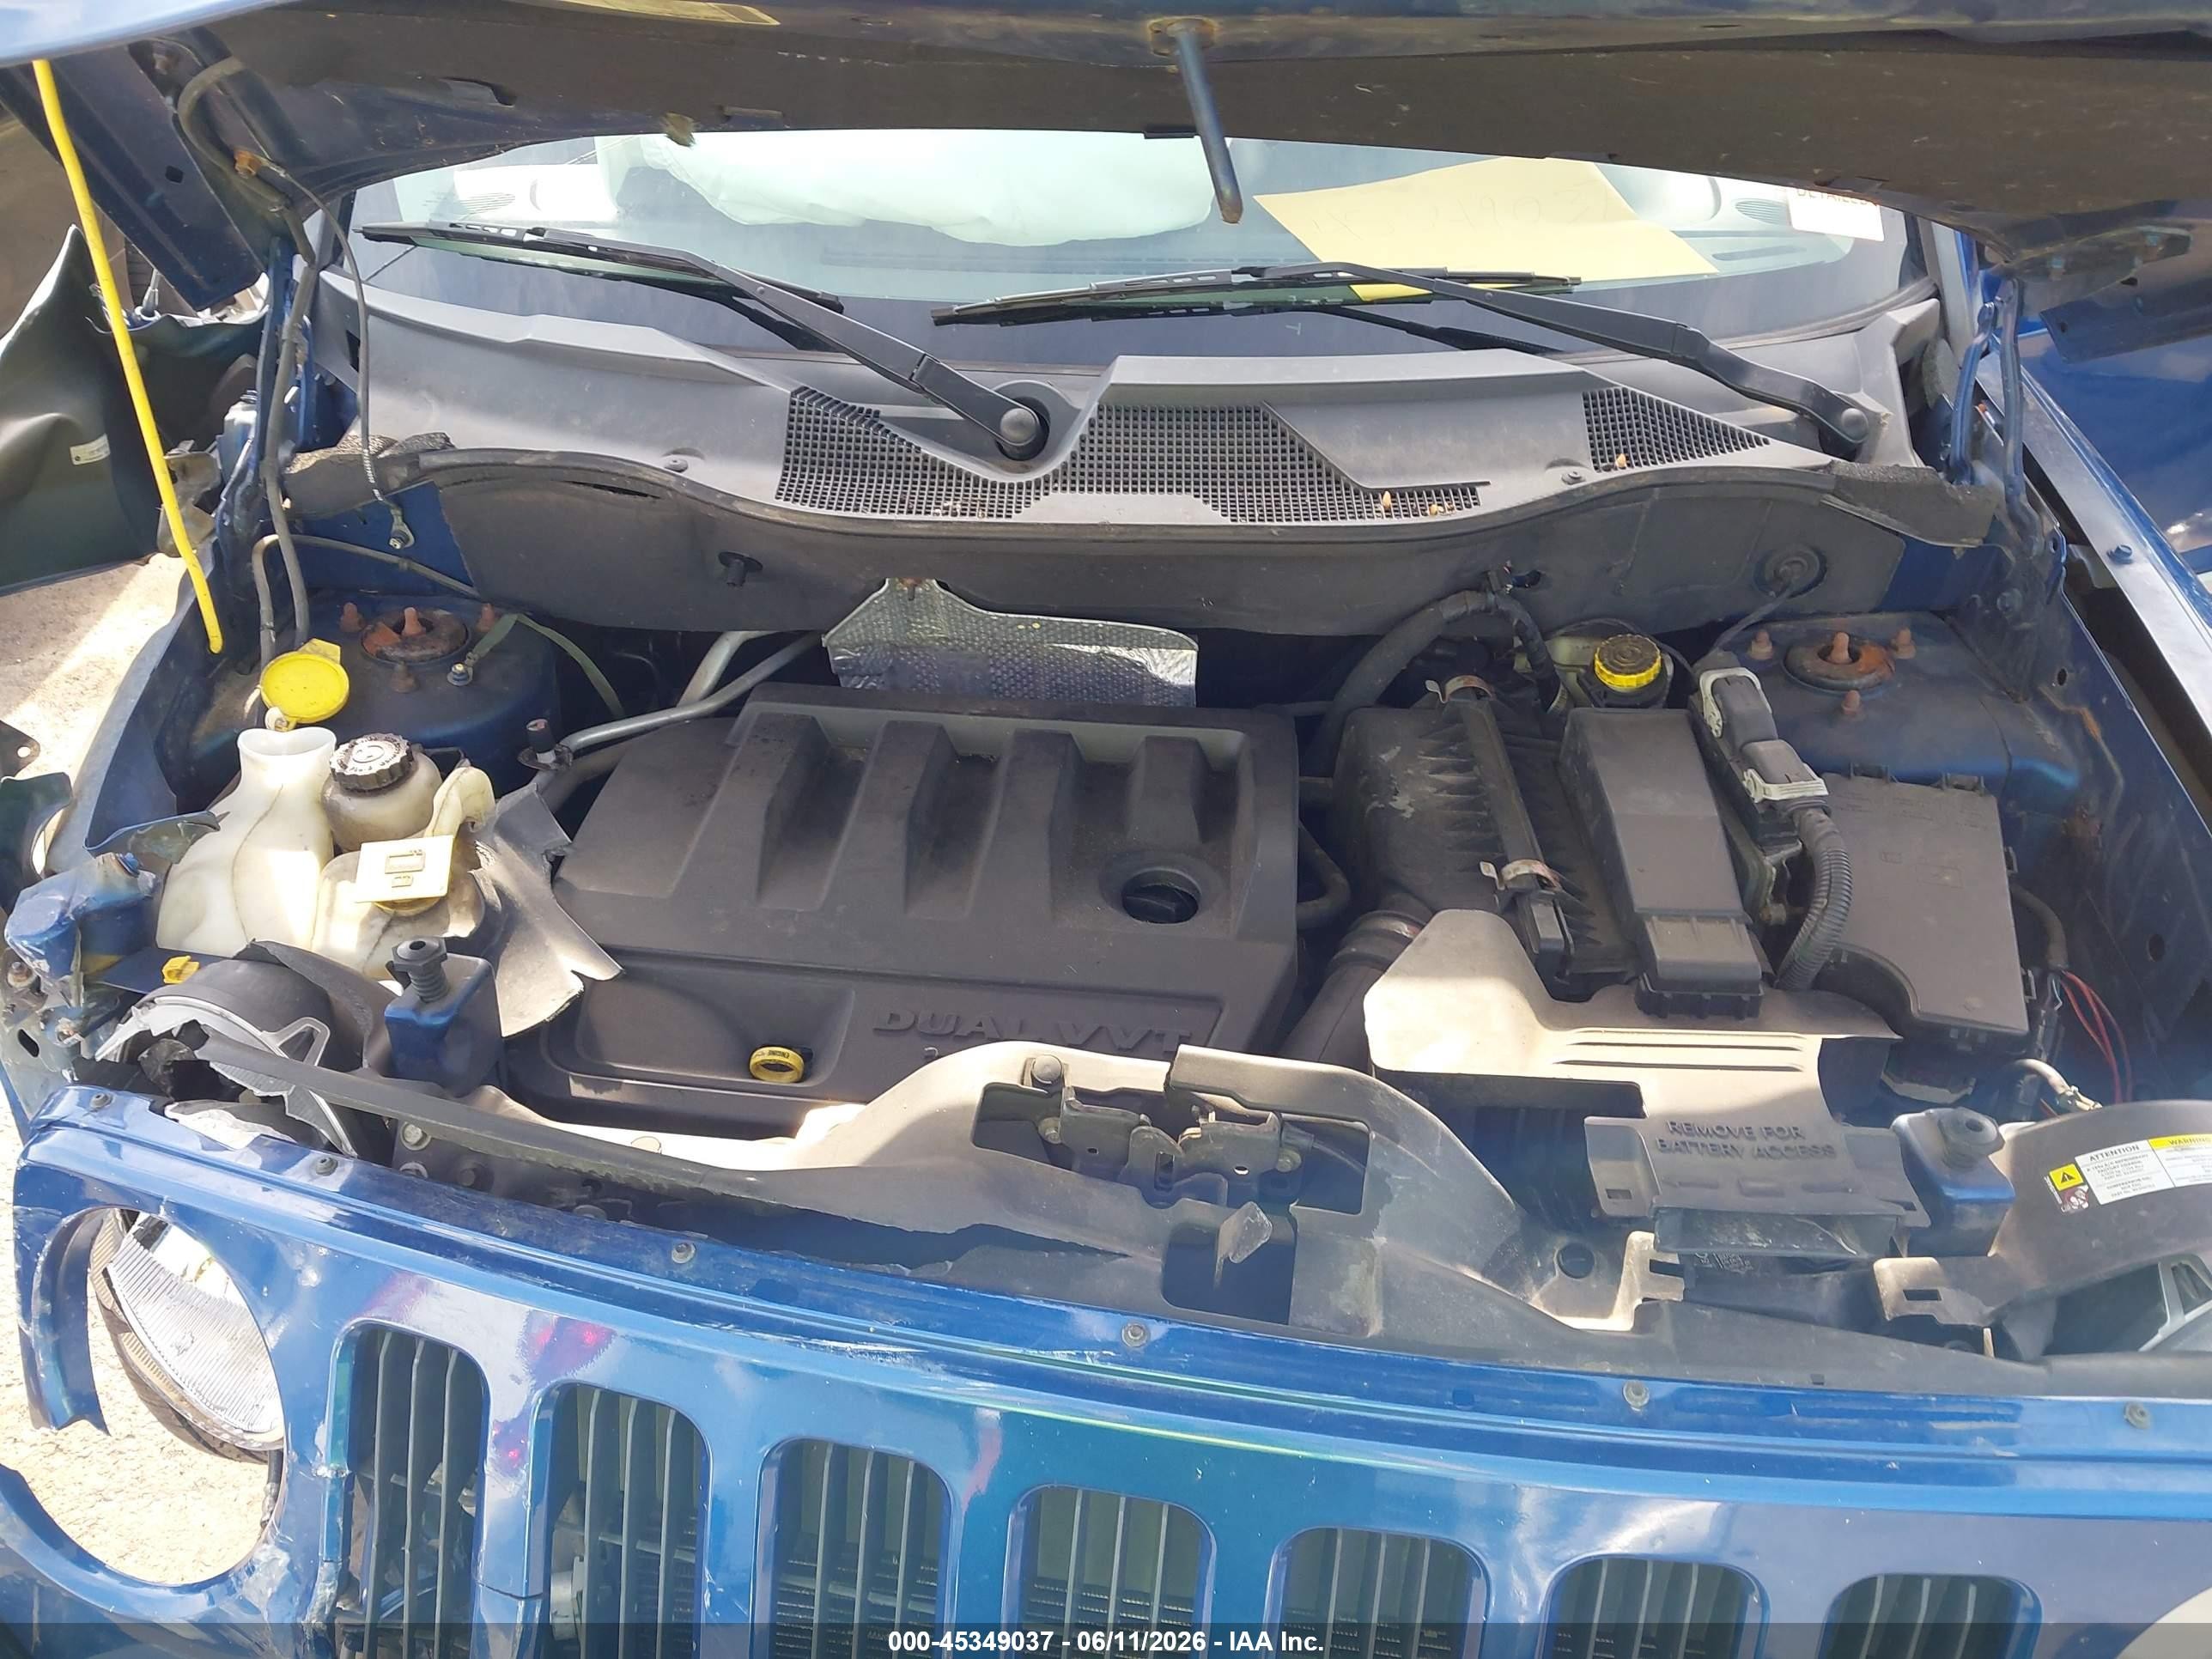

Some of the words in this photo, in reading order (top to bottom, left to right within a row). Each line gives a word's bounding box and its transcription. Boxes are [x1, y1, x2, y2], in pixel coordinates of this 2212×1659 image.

[1054, 1020, 1194, 1054] VVT
[1667, 1121, 1757, 1141] REMOVE
[1761, 1126, 1806, 1140] FOR
[1656, 1137, 1747, 1159] BATTERY
[1751, 1145, 1837, 1160] ACCESS
[2089, 1145, 2140, 1162] ATTENTION
